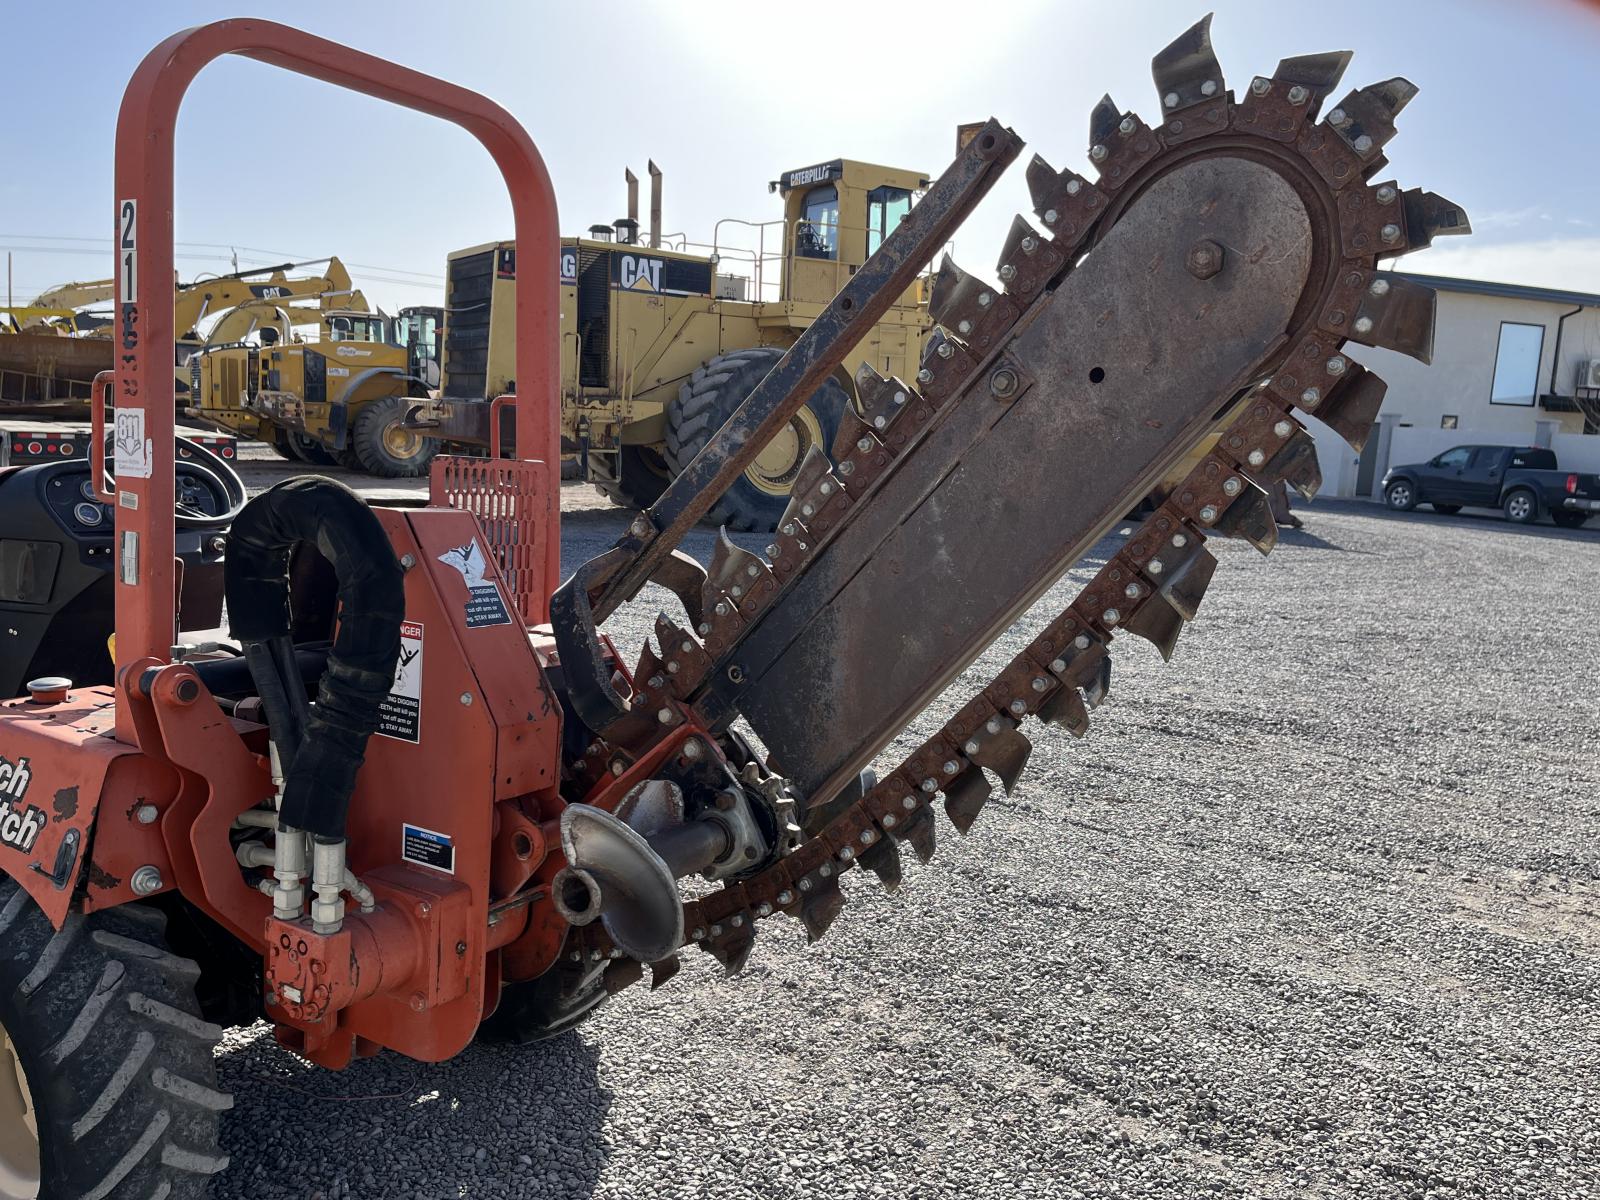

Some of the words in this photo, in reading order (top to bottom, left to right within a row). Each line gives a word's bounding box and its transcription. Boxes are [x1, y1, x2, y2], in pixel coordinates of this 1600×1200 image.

[621, 255, 663, 293] CAT
[263, 286, 281, 300] CAT
[118, 414, 140, 441] 811
[400, 625, 421, 637] NGER
[379, 703, 392, 711] EETH
[397, 698, 418, 708] DIGGING
[386, 723, 398, 731] STAY
